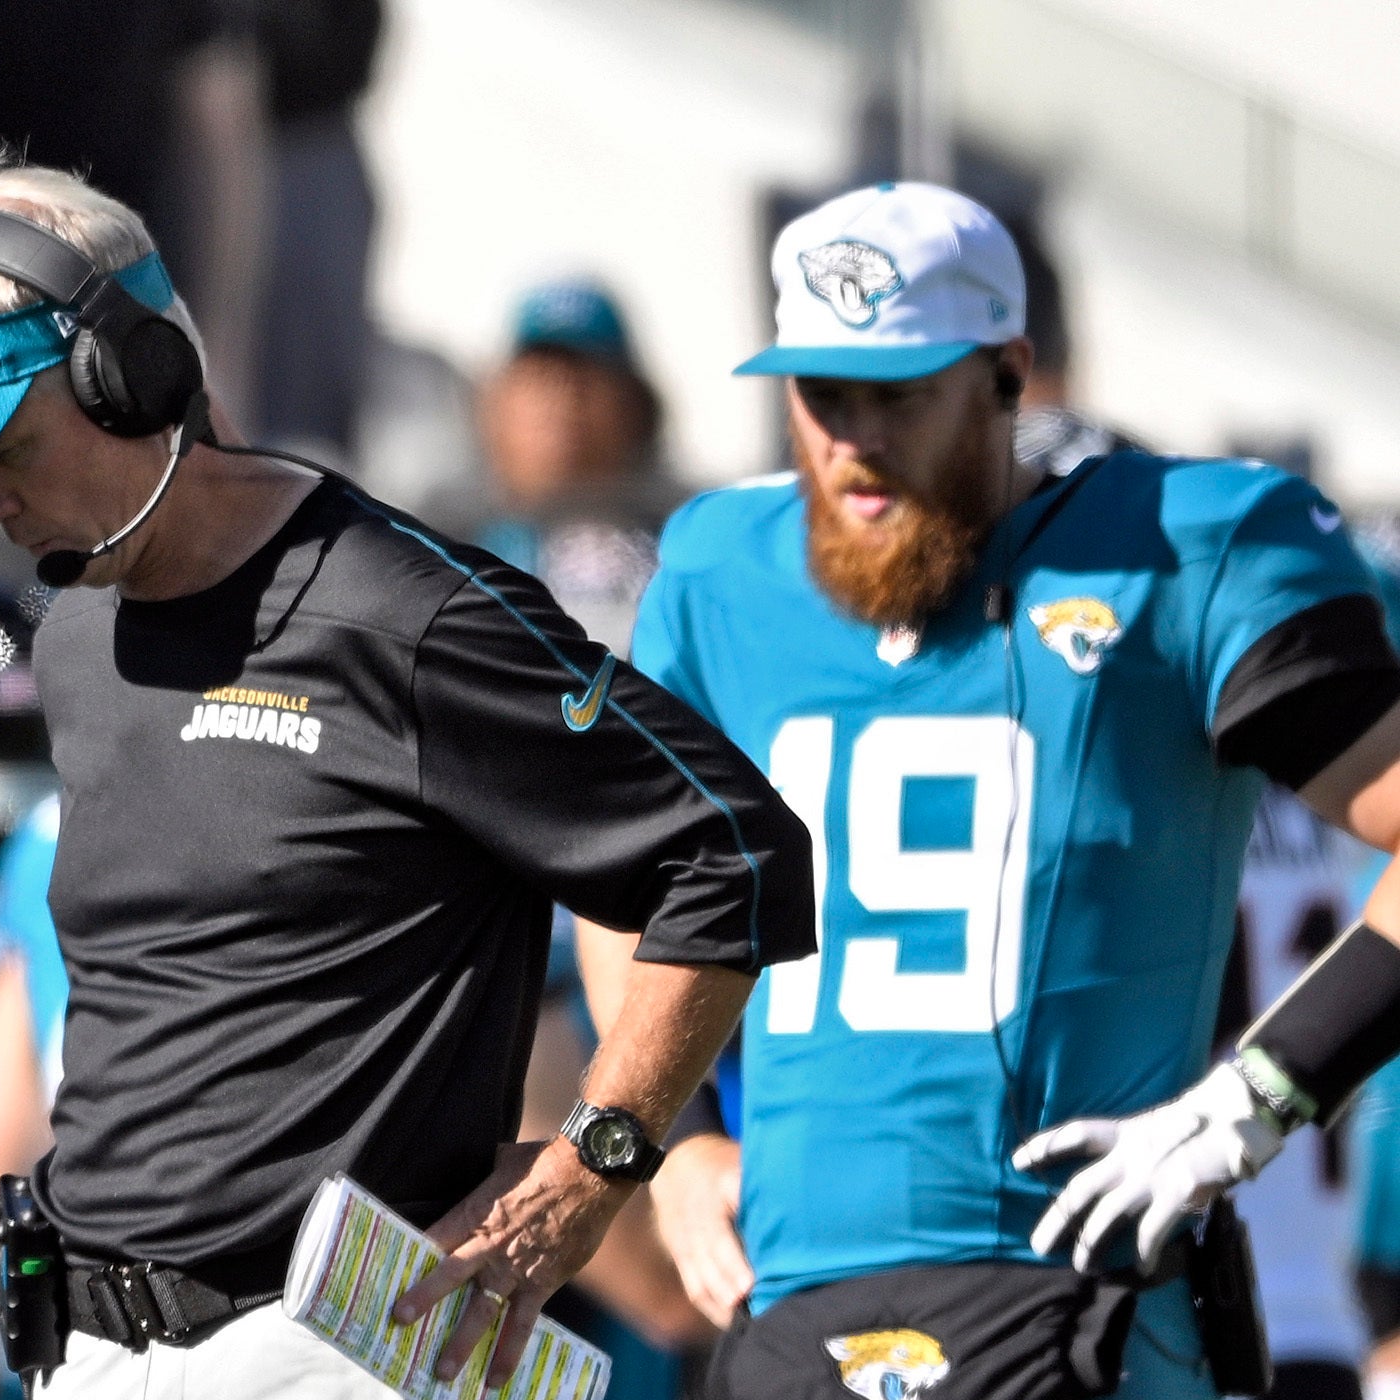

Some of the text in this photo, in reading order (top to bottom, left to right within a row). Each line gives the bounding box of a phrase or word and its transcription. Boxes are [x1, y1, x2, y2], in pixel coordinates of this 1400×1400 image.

[202, 686, 310, 713] JACKSONVILLE
[180, 703, 322, 755] JAGUARS
[766, 714, 1037, 1034] 19
